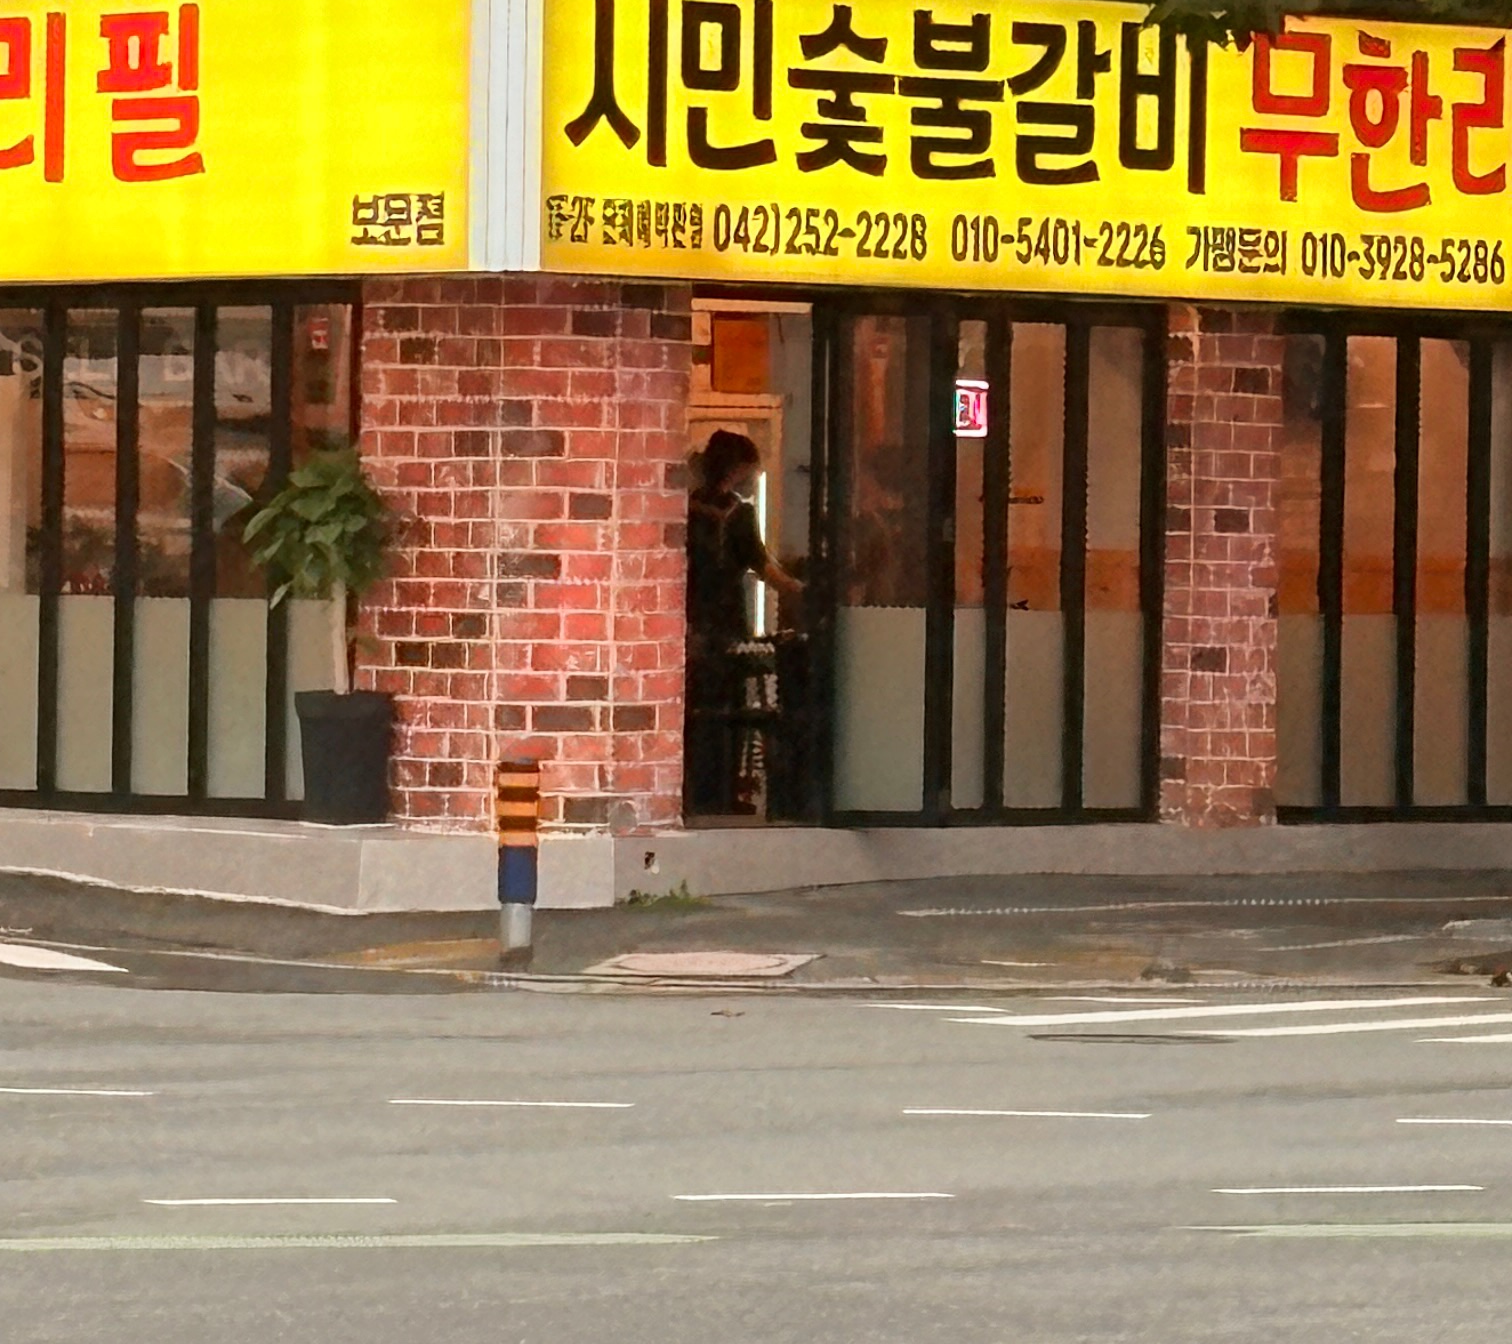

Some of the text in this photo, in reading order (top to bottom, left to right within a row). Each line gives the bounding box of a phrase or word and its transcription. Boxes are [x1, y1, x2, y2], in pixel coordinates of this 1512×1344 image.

[350, 191, 445, 246] 보문점
[713, 203, 928, 261] 042)252-2228
[951, 213, 1167, 272] 010-5401-2226
[1186, 225, 1288, 276] 가맹문의
[1301, 231, 1506, 286] 010-3928-5286
